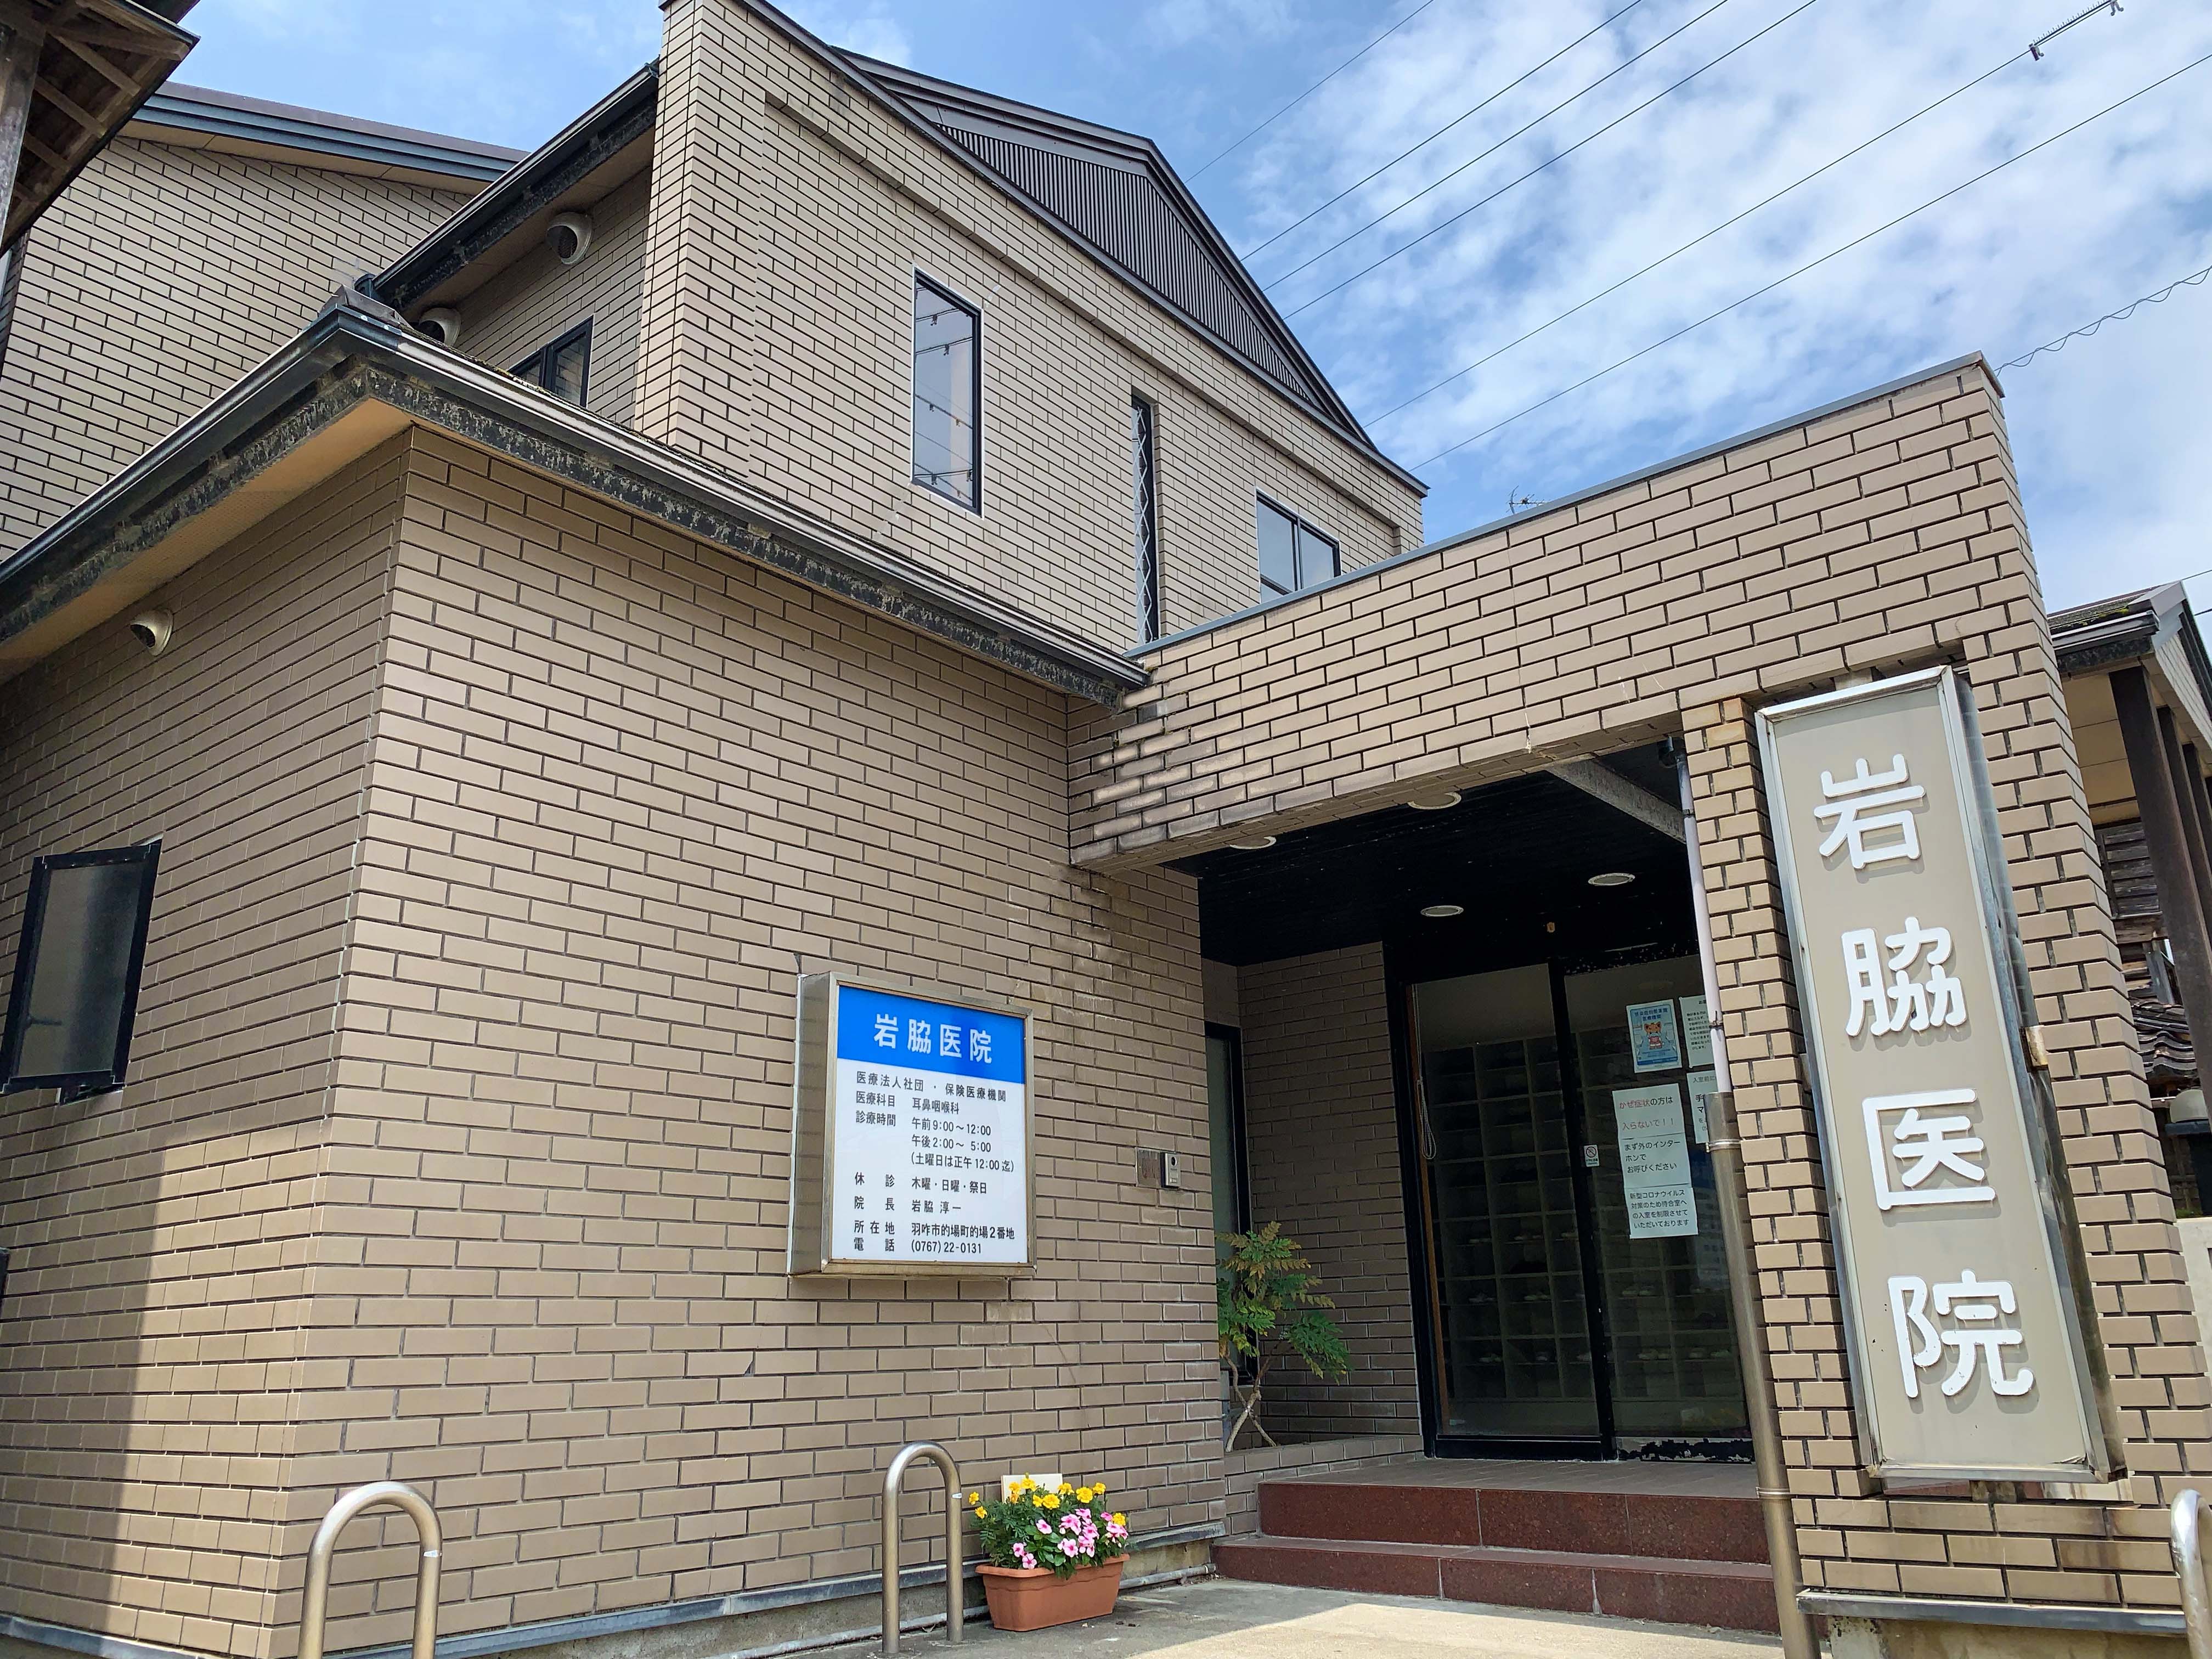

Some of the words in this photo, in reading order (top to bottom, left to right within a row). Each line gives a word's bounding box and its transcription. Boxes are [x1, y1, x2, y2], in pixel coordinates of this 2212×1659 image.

[873, 1013, 992, 1063] 岩脇医院
[1814, 753, 2034, 1399] 岩脇医院
[856, 1071, 923, 1092] 医療法人社団
[945, 1083, 1006, 1102] 保険医療機関
[856, 1091, 895, 1107] 医療科目
[912, 1098, 959, 1114] 耳鼻咽喉科
[1620, 1096, 1673, 1109] かぜ症状の方は
[856, 1110, 896, 1127] 診療時間
[1624, 1140, 1680, 1151] まず外のインター
[1626, 1154, 1646, 1162] ホンで
[1627, 1163, 1677, 1173] お呼びください
[911, 1177, 987, 1194] 木曜・日曜・祭日
[1630, 1189, 1685, 1199] 新型コロナウイルス
[1631, 1200, 1688, 1210] 対策のため待合室へ
[1633, 1209, 1688, 1219] の入室を制限させて
[1634, 1219, 1689, 1229] いただいております
[911, 1223, 1015, 1240] 羽咋市的場町的場2番地
[911, 1239, 982, 1254] (0767)22-0131
